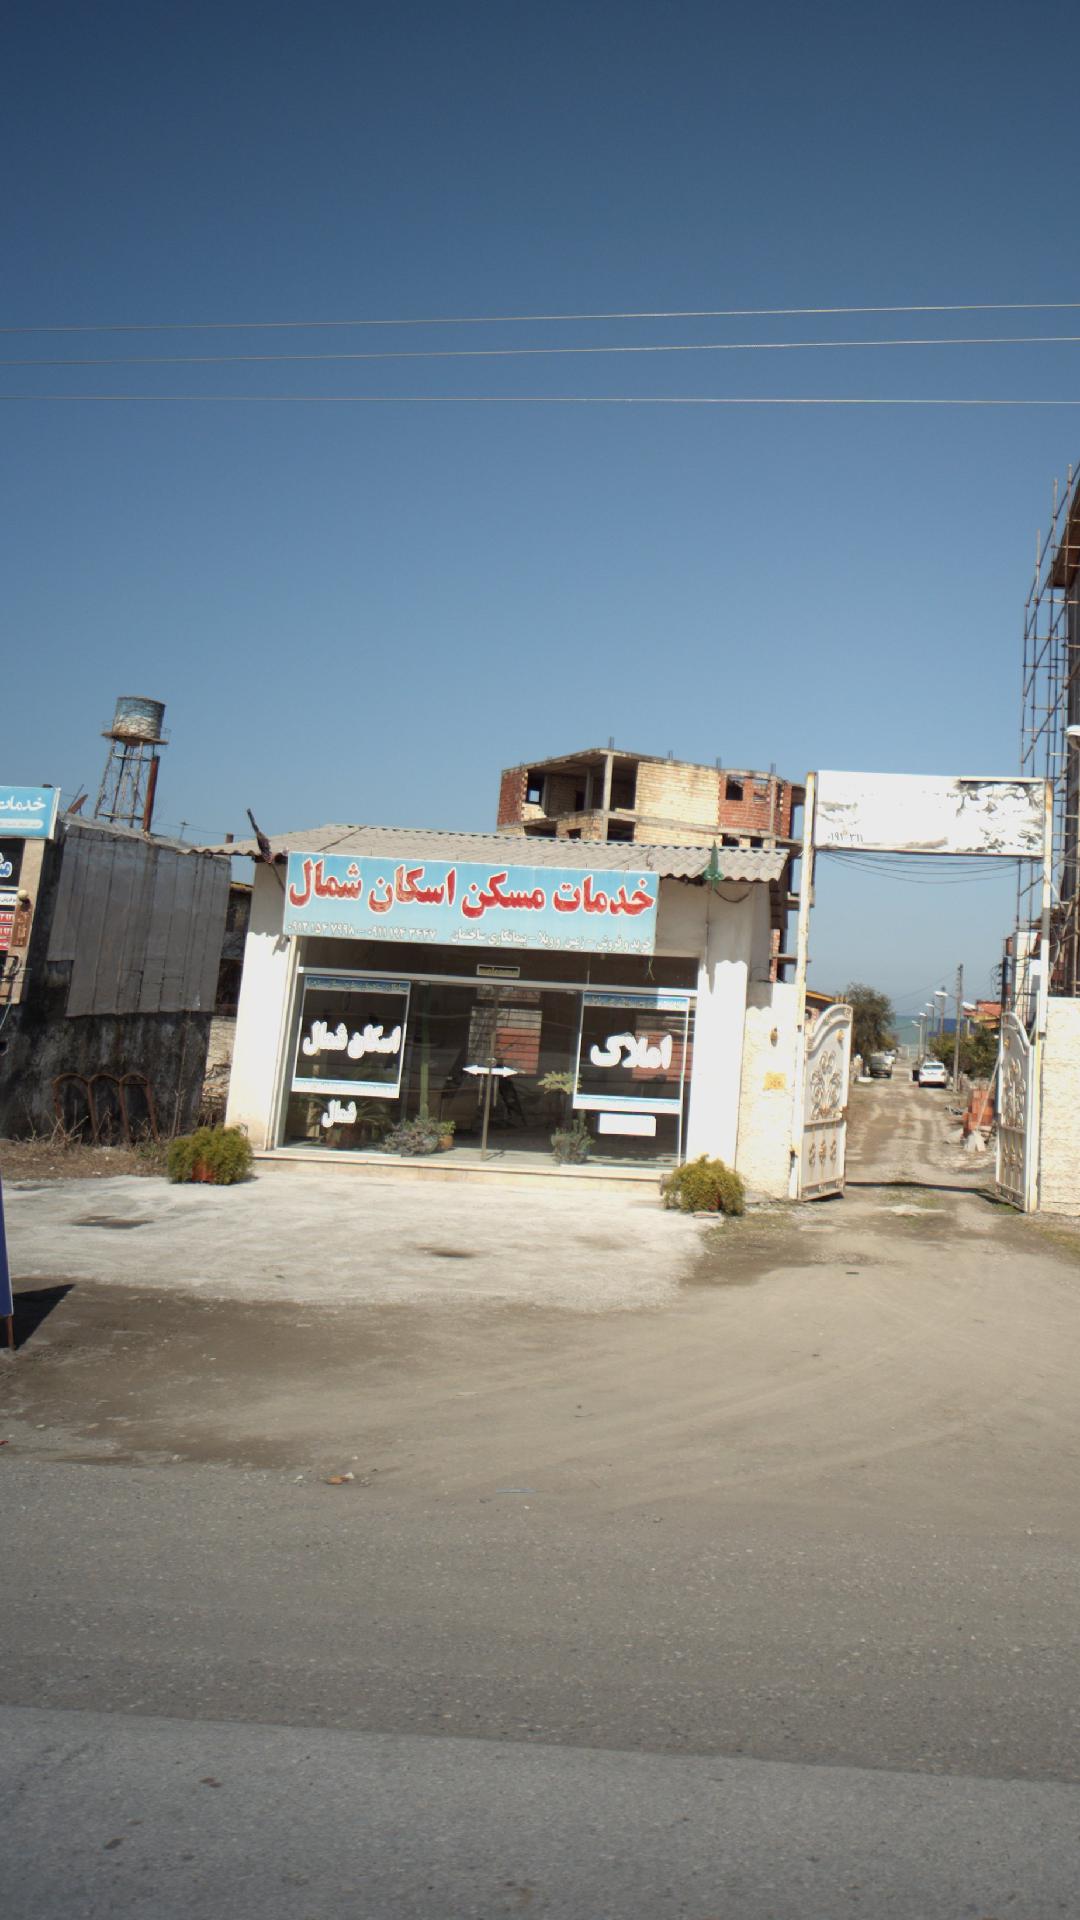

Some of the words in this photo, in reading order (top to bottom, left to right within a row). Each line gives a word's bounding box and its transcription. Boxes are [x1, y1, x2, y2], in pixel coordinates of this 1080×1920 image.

[289, 858, 363, 907] شمال
[368, 864, 456, 913] اسکان
[461, 870, 546, 918] مسکن
[553, 875, 654, 916] خدمات
[451, 928, 486, 943] ساختمان
[303, 1021, 348, 1056] شمال
[347, 1024, 401, 1059] اسکان
[590, 1031, 673, 1070] املاک
[322, 1099, 357, 1128] شمال
